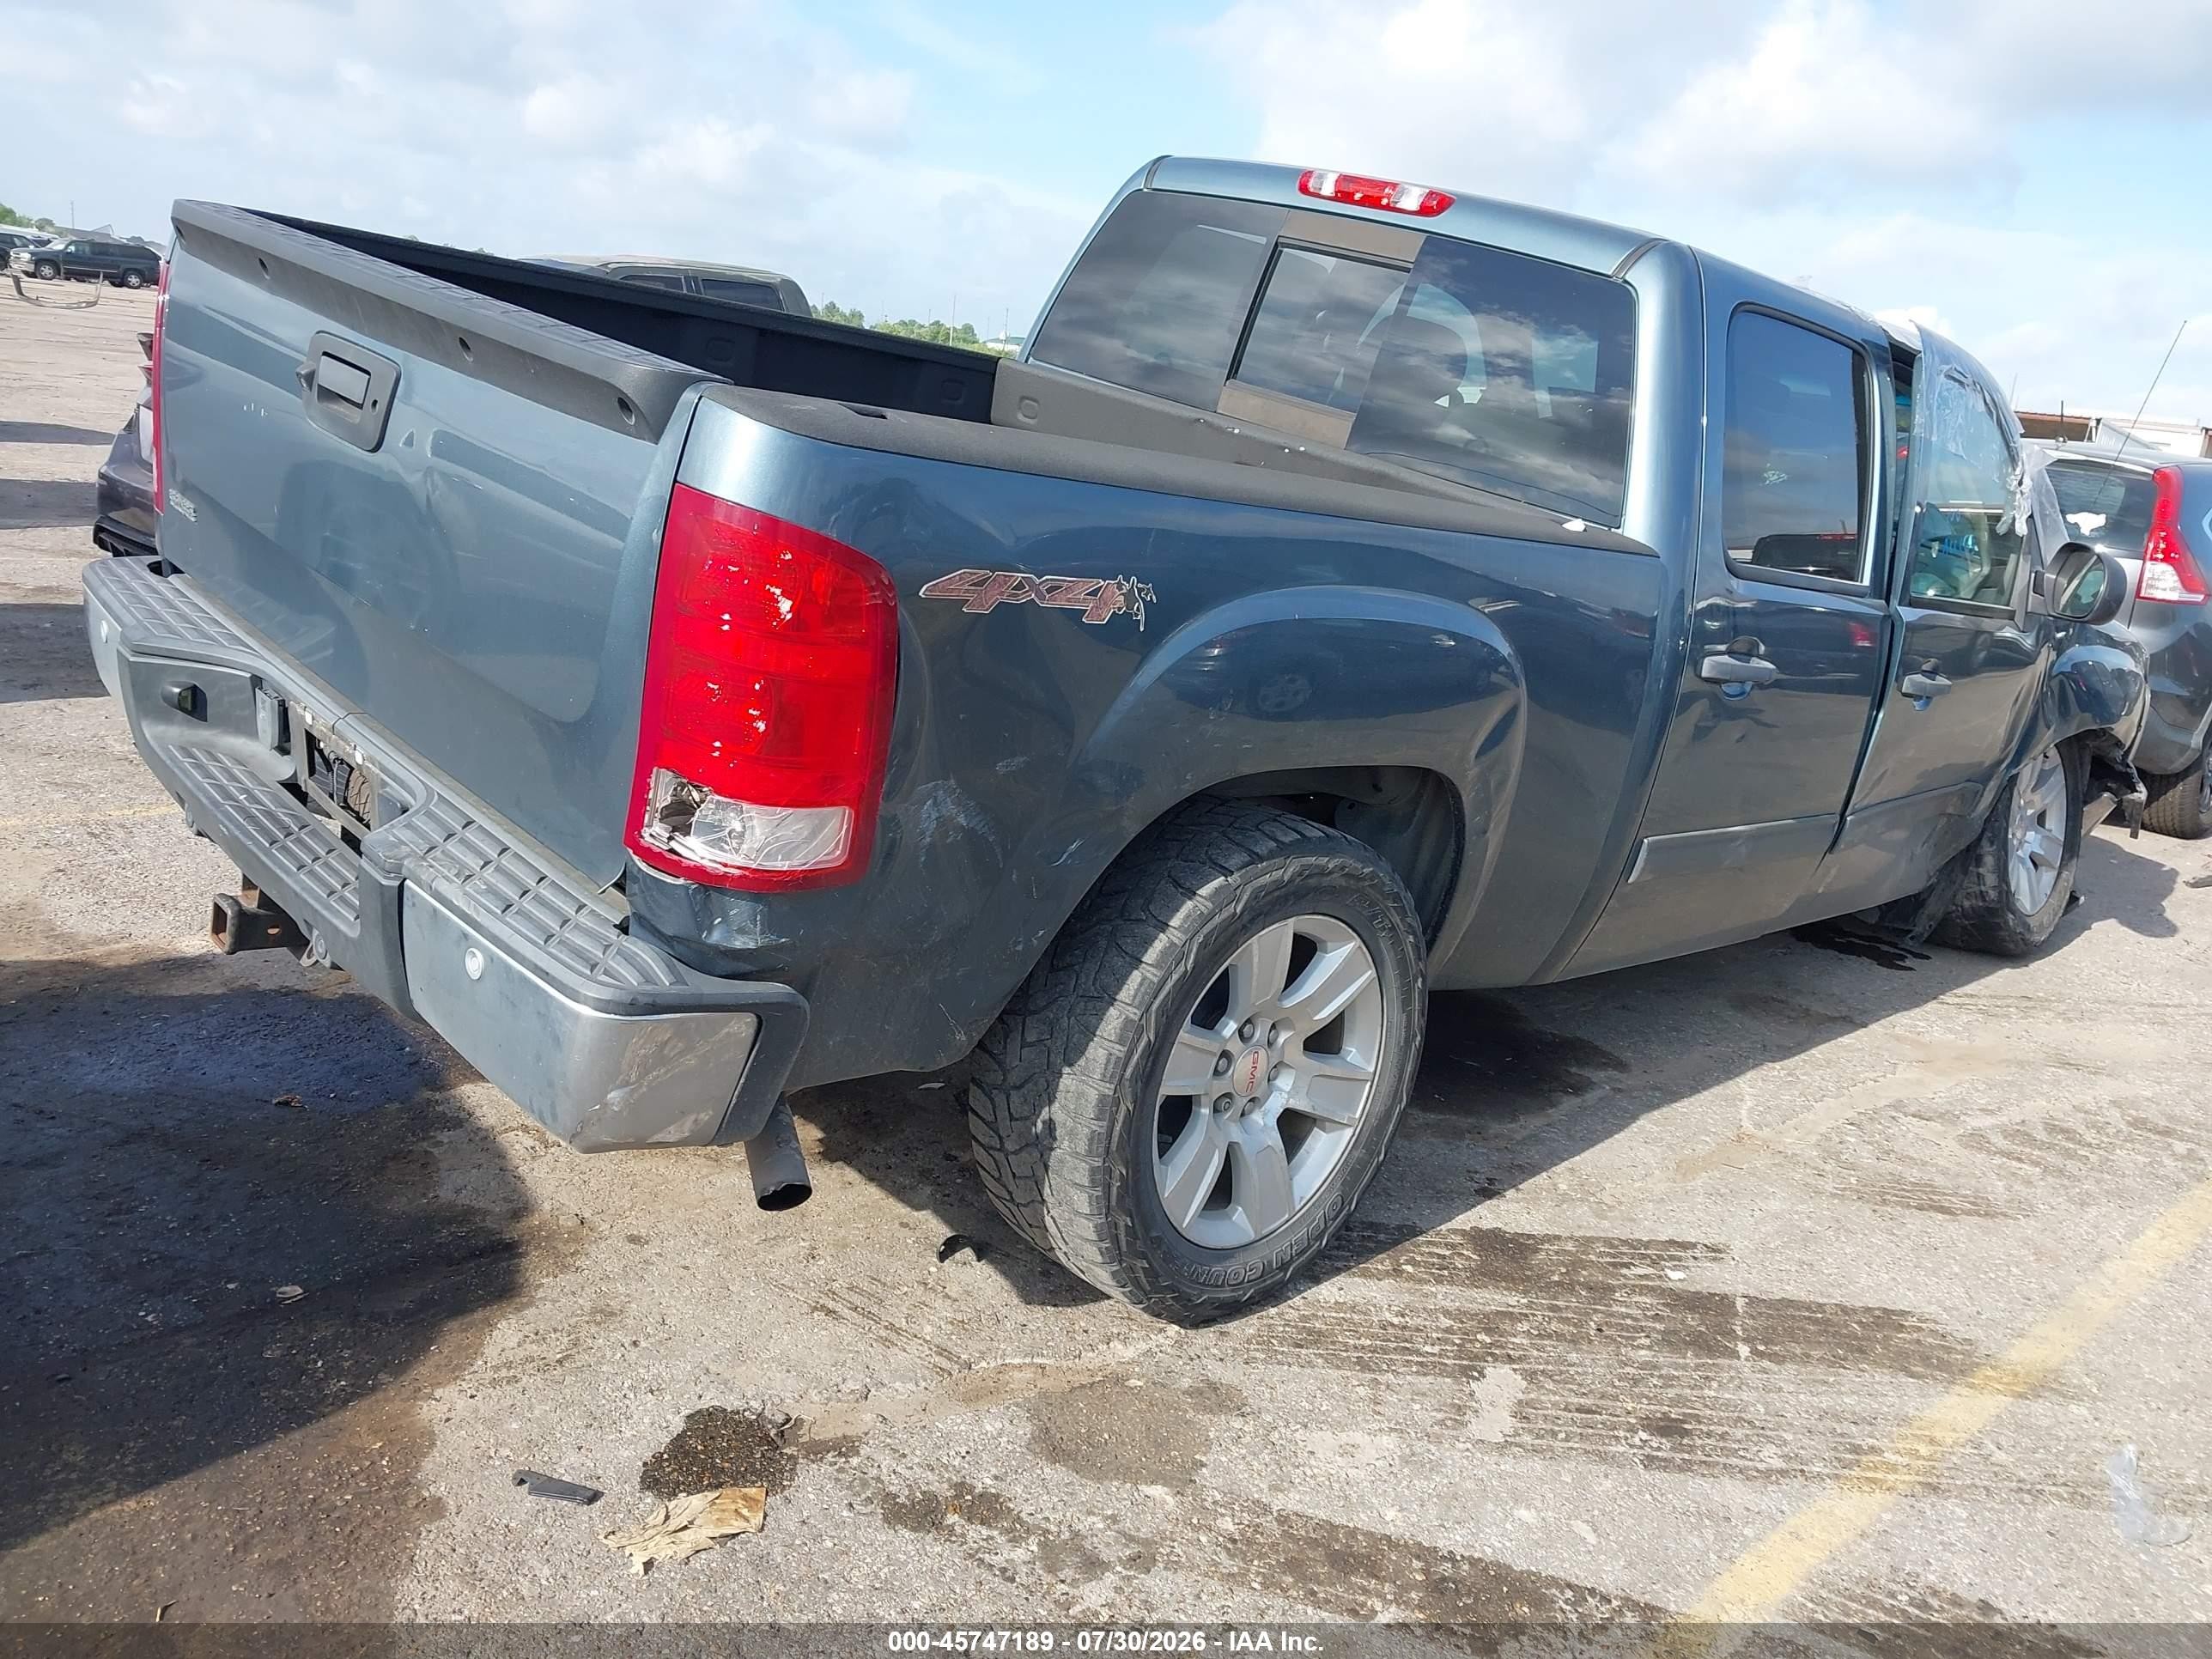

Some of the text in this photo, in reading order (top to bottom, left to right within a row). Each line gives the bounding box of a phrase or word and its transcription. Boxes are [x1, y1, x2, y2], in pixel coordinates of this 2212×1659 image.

[1245, 1050, 1260, 1094] GMC
[1170, 1192, 1344, 1287] OPEN COUN
